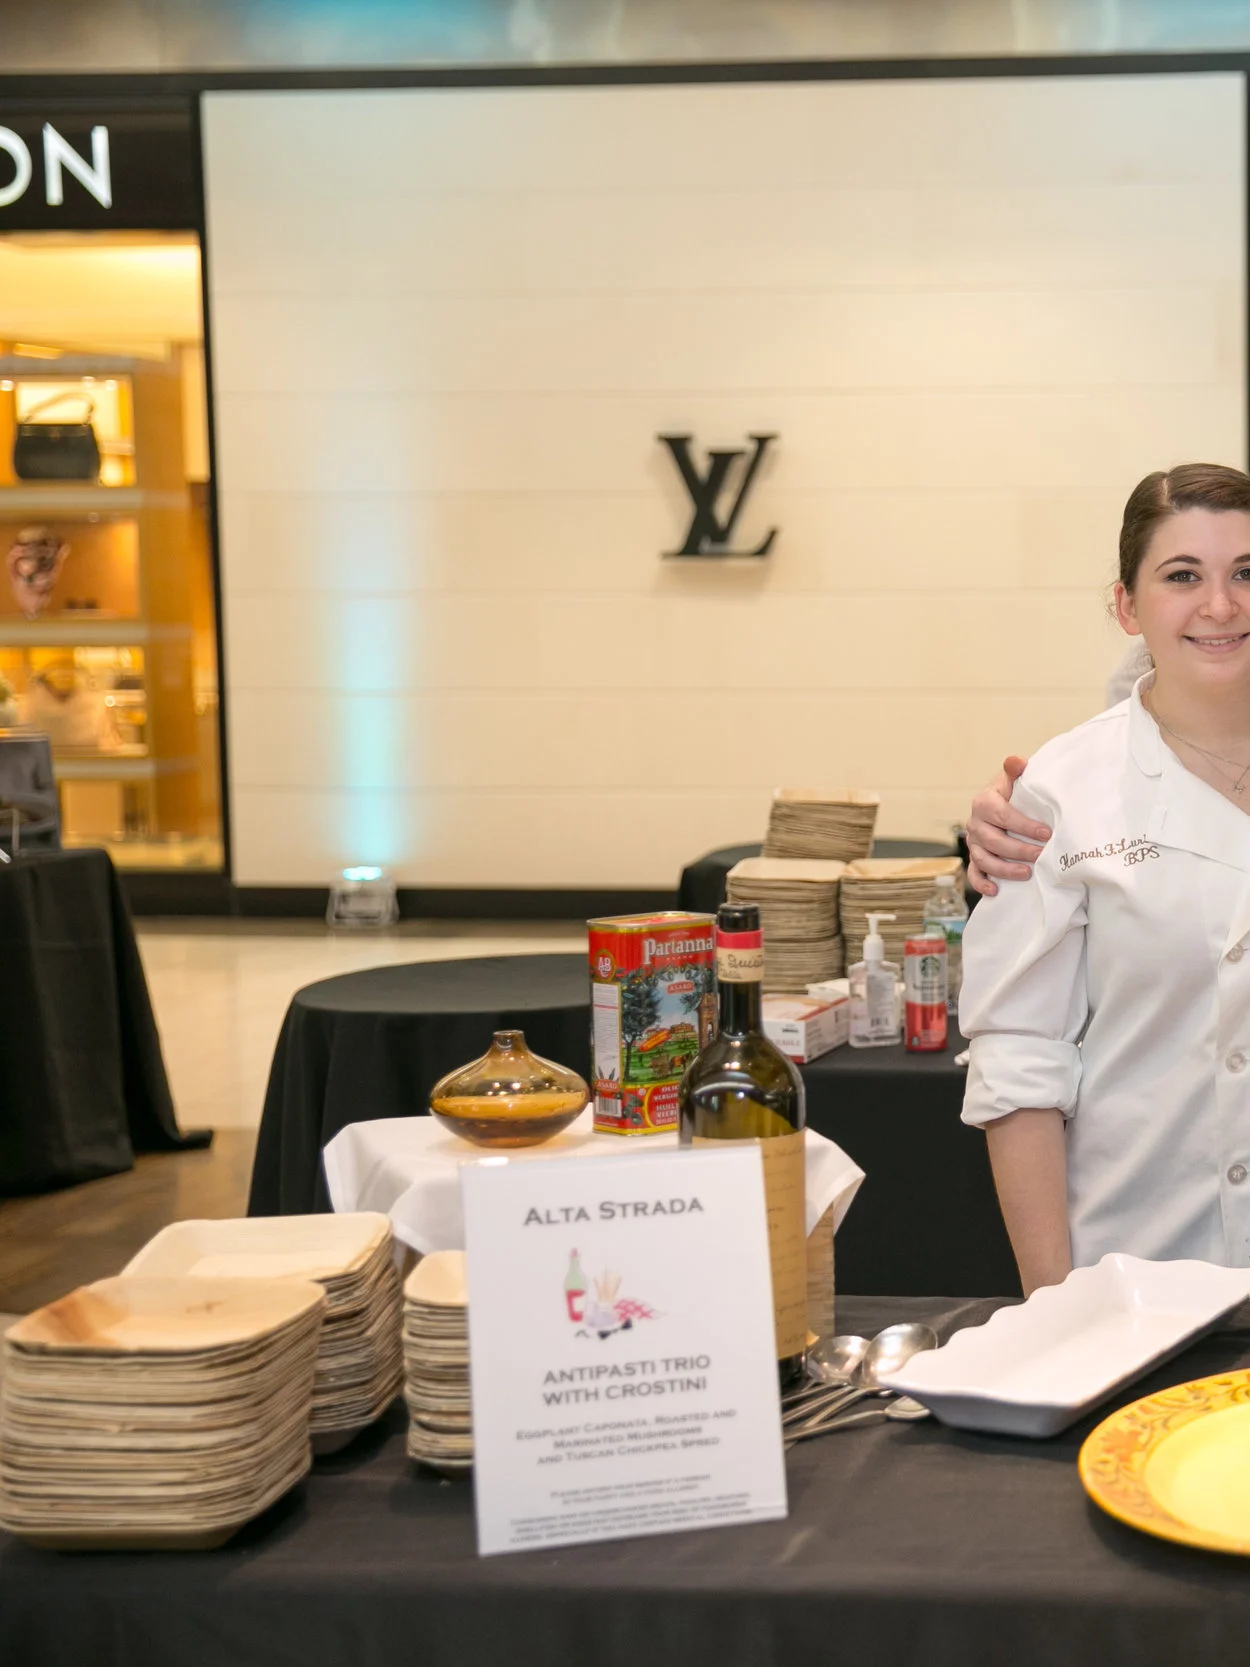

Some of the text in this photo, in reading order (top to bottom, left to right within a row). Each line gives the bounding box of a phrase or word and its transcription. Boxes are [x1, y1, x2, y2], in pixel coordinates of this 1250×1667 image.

[1059, 847, 1103, 871] Hannah
[643, 937, 713, 964] Partanna
[523, 1196, 704, 1228] ALTA STRADA
[543, 1354, 711, 1386] ANTIPASTI TRIO
[542, 1376, 708, 1407] WITH CROSTINI
